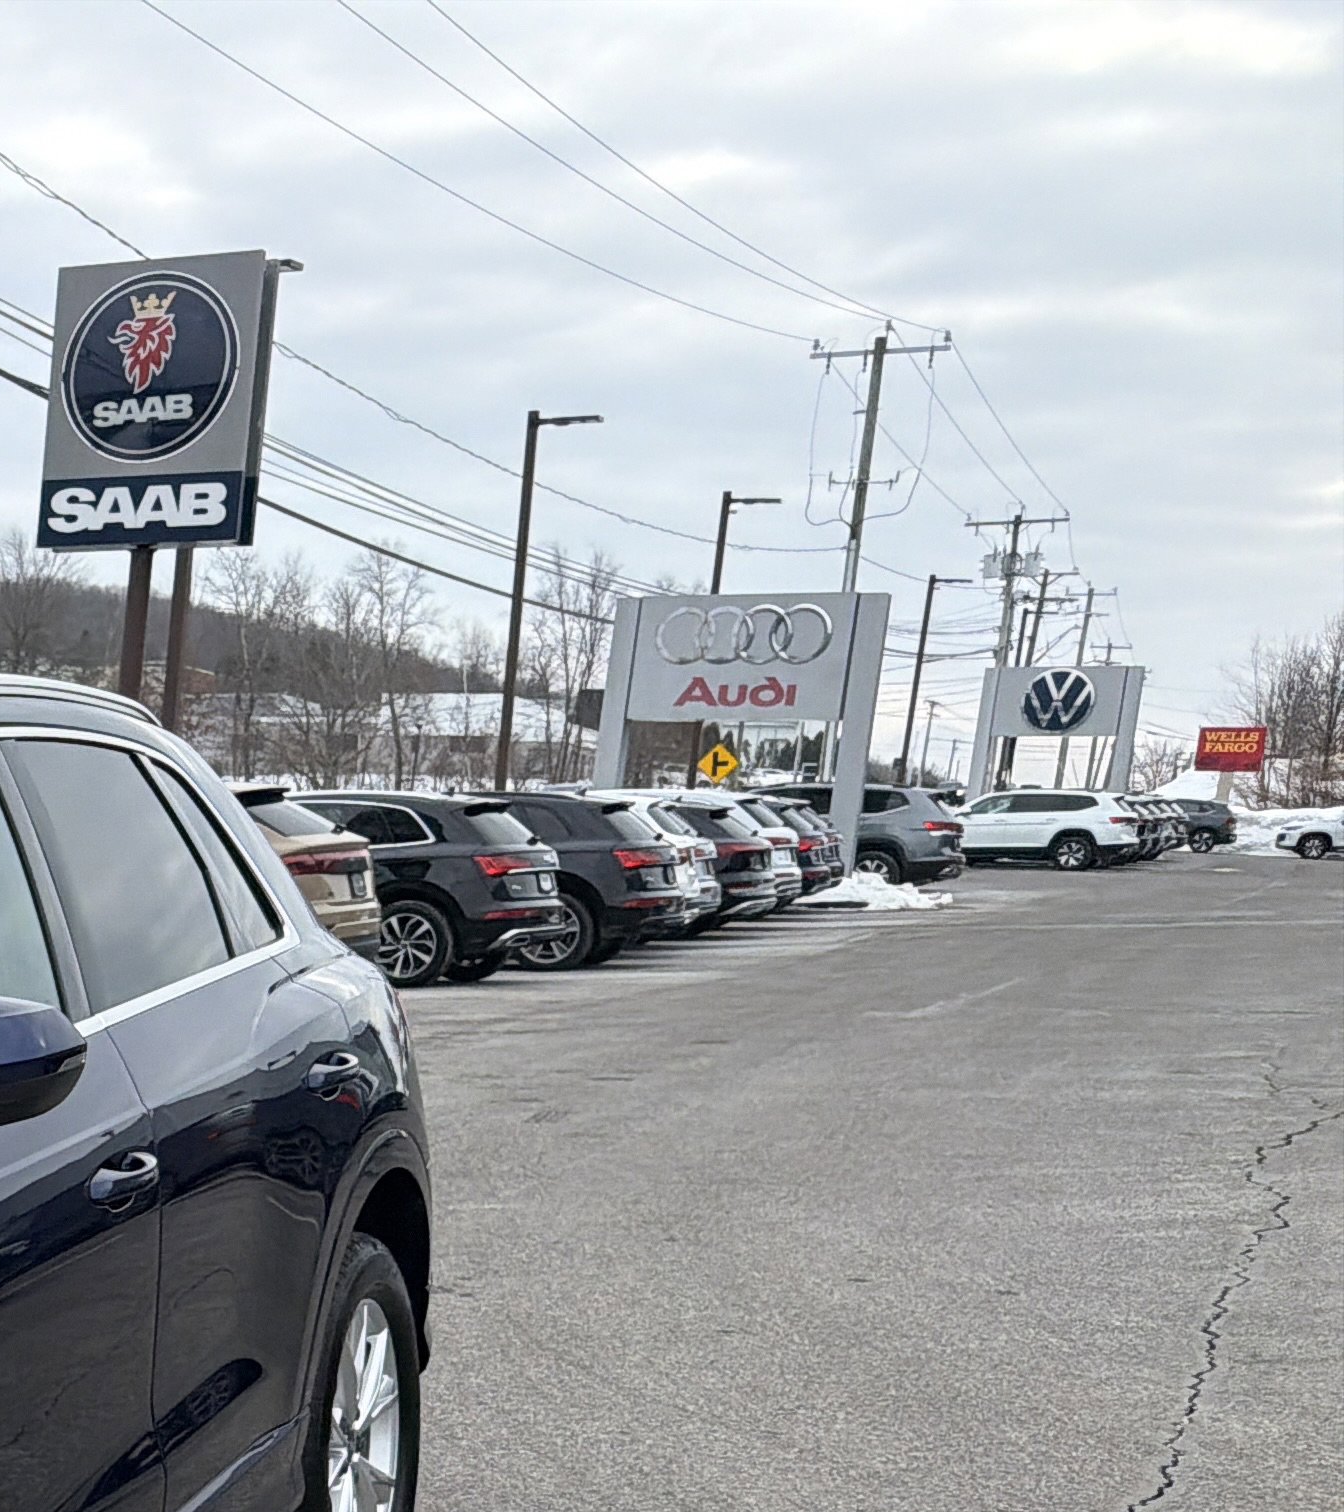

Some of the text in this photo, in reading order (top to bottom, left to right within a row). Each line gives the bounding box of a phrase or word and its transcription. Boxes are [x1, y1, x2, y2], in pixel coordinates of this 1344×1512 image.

[93, 393, 193, 428] SAAB
[47, 482, 227, 533] SAAB
[673, 677, 797, 707] Audi
[1204, 742, 1258, 753] FARGO
[1205, 731, 1260, 742] WELLS
